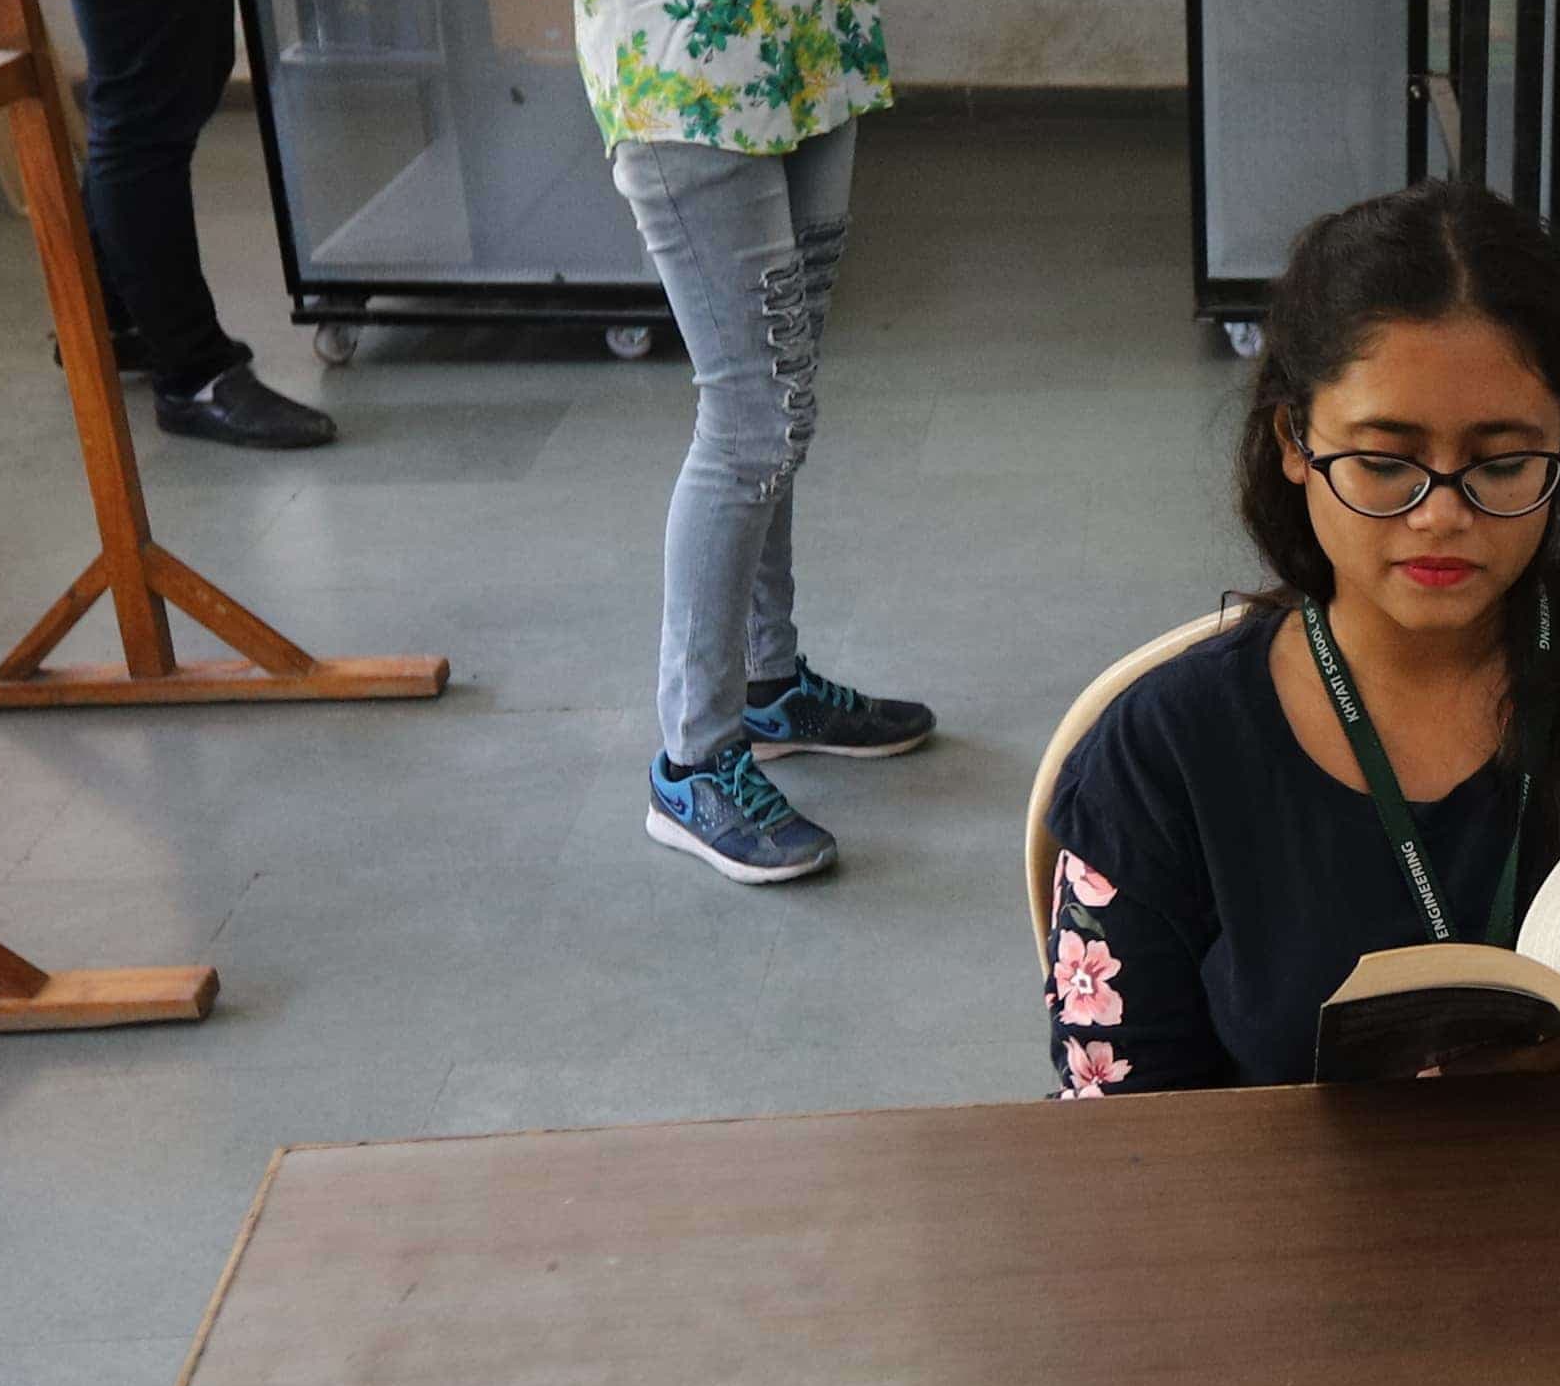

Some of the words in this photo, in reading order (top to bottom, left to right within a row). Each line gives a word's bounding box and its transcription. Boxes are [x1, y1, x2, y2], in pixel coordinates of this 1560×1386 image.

[1306, 607, 1317, 623] OF
[1312, 623, 1338, 675] SCHOOL
[1330, 674, 1360, 723] KHYATI
[1401, 840, 1450, 941] ENGINEERING
